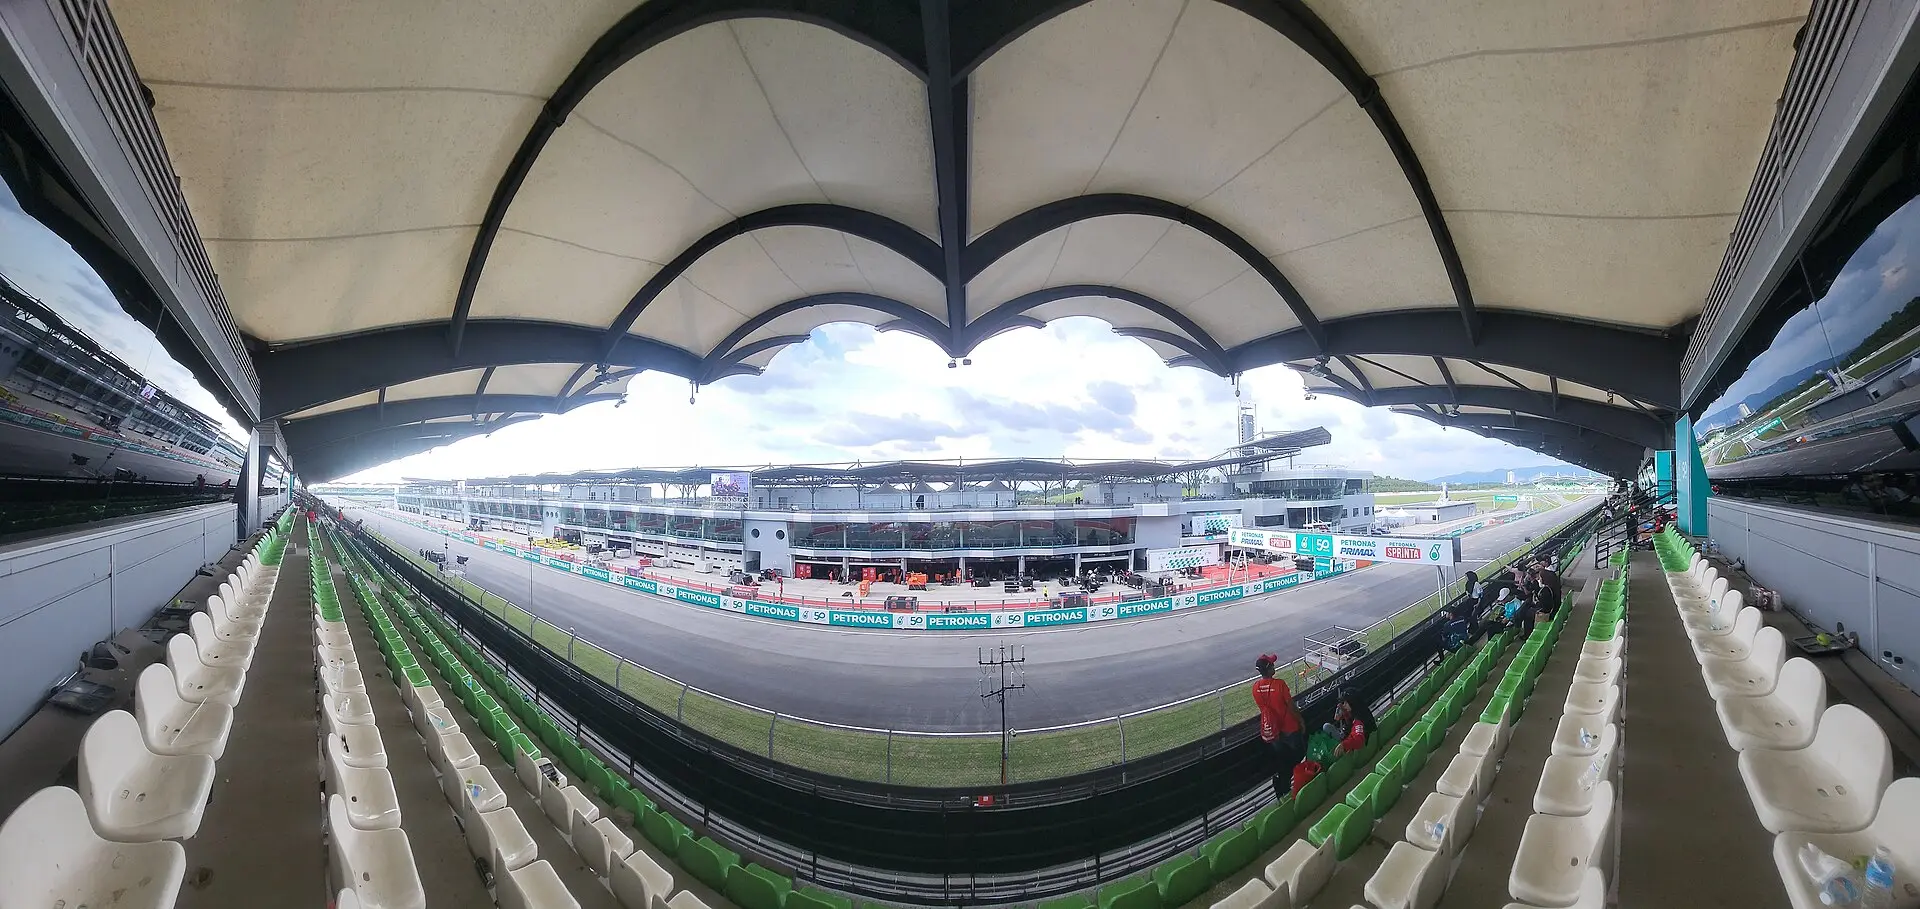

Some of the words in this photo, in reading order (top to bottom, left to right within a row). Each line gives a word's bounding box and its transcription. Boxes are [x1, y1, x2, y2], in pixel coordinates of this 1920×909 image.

[1316, 539, 1330, 551] 50
[1340, 548, 1376, 557] PRIMAX
[1387, 547, 1419, 559] SPRINTA
[550, 560, 570, 569] PETRONAS
[583, 567, 608, 578] PETRONAS
[626, 579, 655, 590] PETRONAS
[1264, 577, 1297, 589] PETRONAS
[678, 591, 718, 605] PETRONAS
[1200, 588, 1241, 602] PETRONAS
[748, 605, 796, 618] PETRONAS
[1102, 607, 1114, 617] 50
[1120, 601, 1169, 614] PETRONAS
[814, 612, 826, 620] 50
[833, 614, 889, 624] PETRONAS
[910, 614, 923, 625] 50
[929, 616, 987, 626] PETRONAS
[1008, 614, 1020, 624] 50
[1027, 611, 1083, 623] PETRONAS
